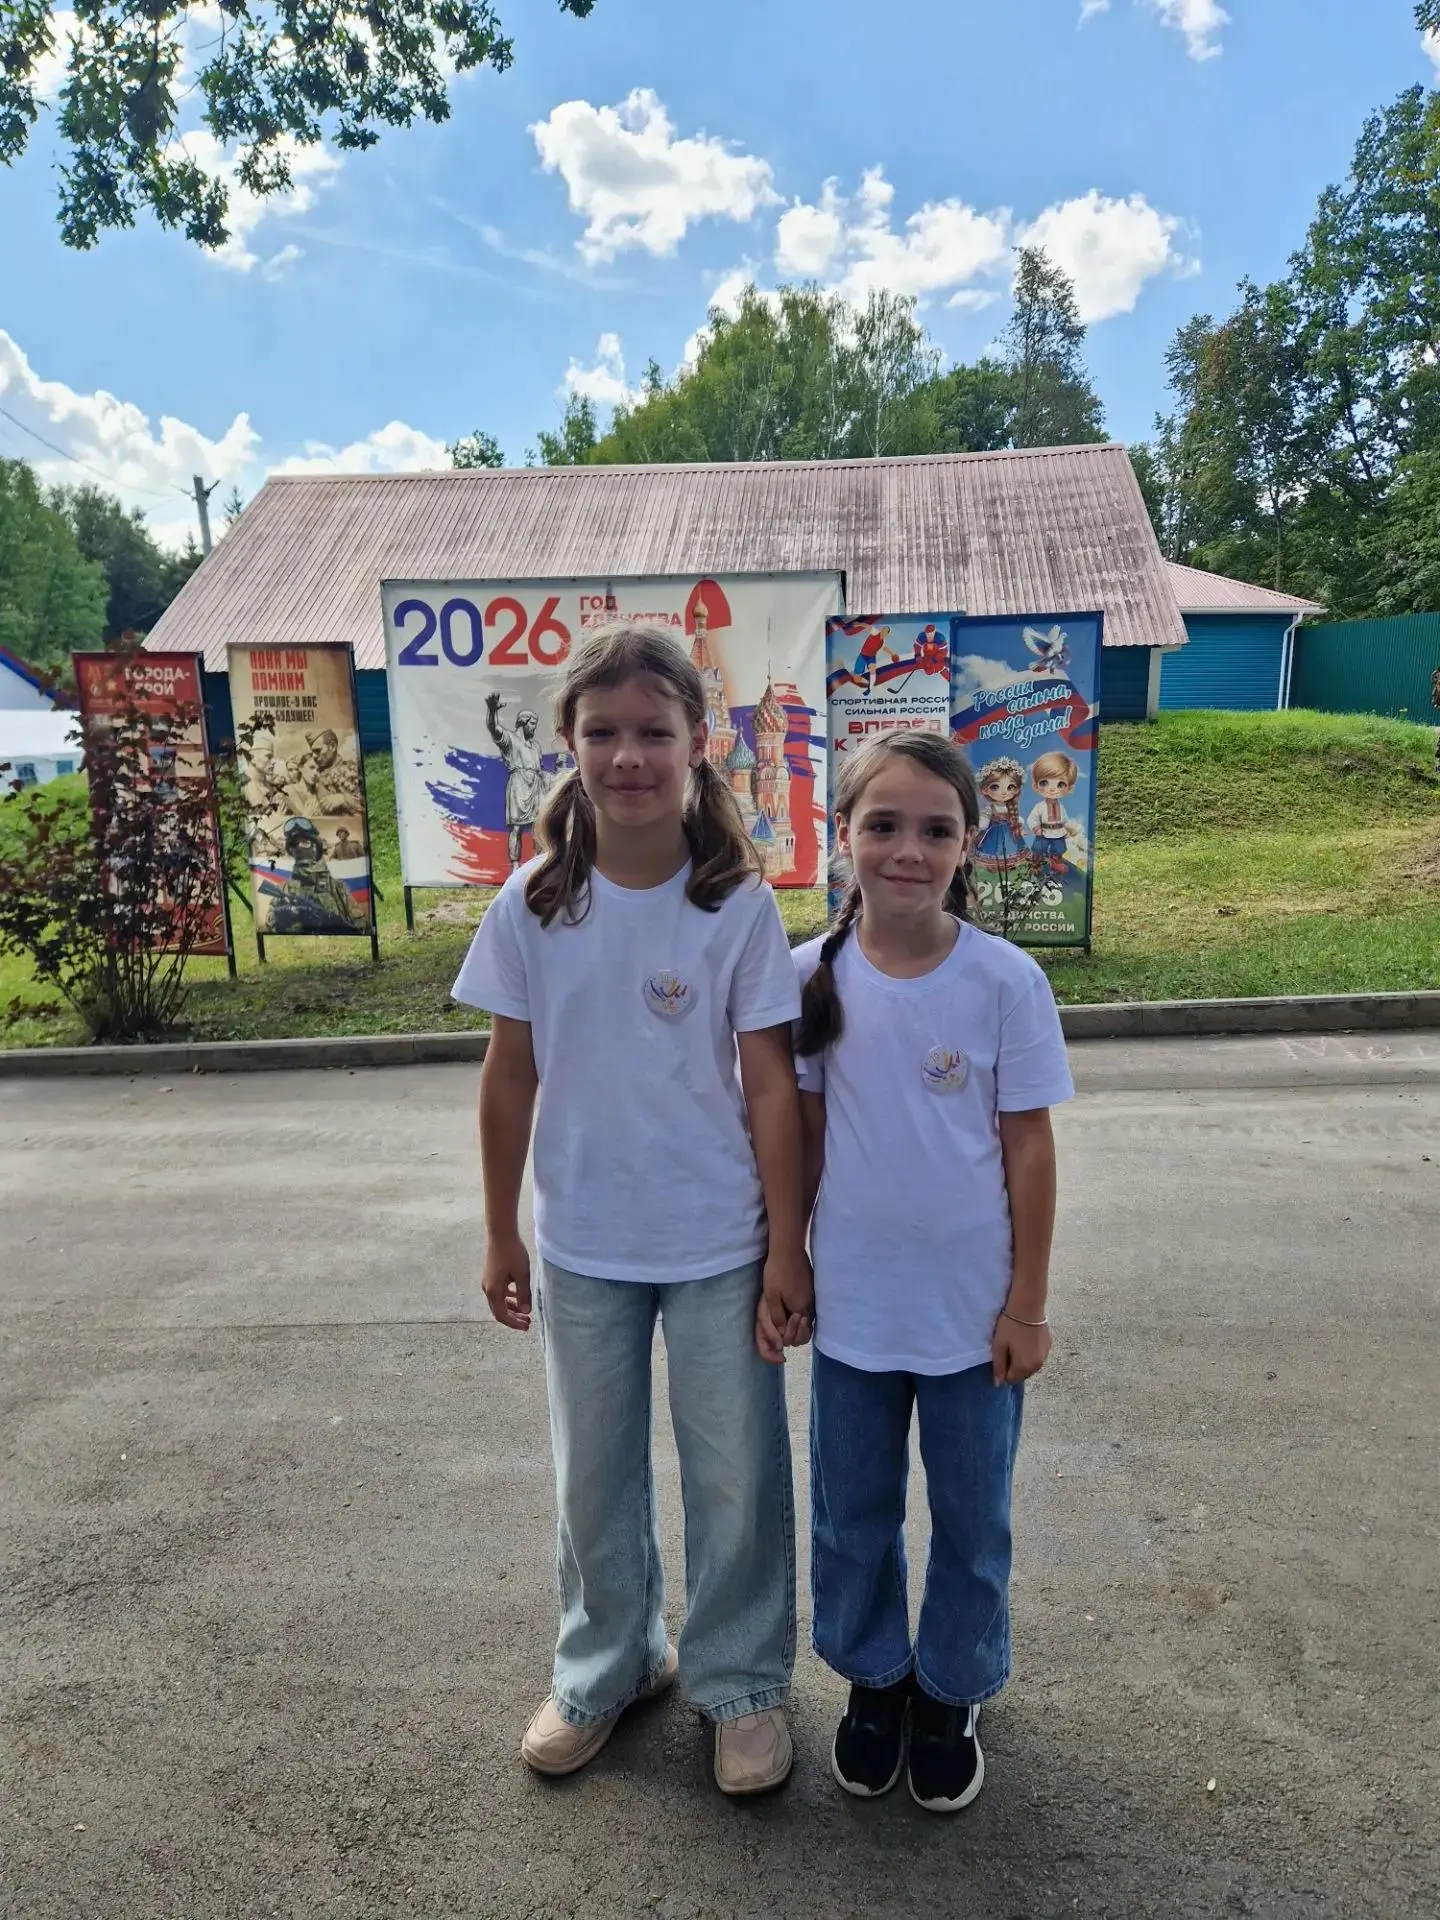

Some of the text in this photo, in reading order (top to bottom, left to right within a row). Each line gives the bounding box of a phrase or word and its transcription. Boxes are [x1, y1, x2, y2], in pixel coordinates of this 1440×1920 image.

[579, 596, 619, 612] ГОД
[580, 612, 683, 627] ЕДНСТВА
[393, 596, 572, 667] 2026
[285, 650, 308, 669] МЫ
[127, 682, 175, 696] ЕРОИ
[252, 671, 306, 691] ПОМНИМ
[831, 696, 950, 706] СПОРТИВНАЯ РОССИ
[972, 681, 1034, 711] Россия
[1006, 684, 1072, 714] сильна,
[844, 706, 947, 716] СИЛЬНАЯ РОССИЯ
[979, 713, 1025, 740] когда
[1013, 705, 1073, 749] едина!
[834, 738, 848, 752] К
[998, 910, 1066, 921] ДИНСТВА
[1024, 922, 1076, 933] РОССИИ
